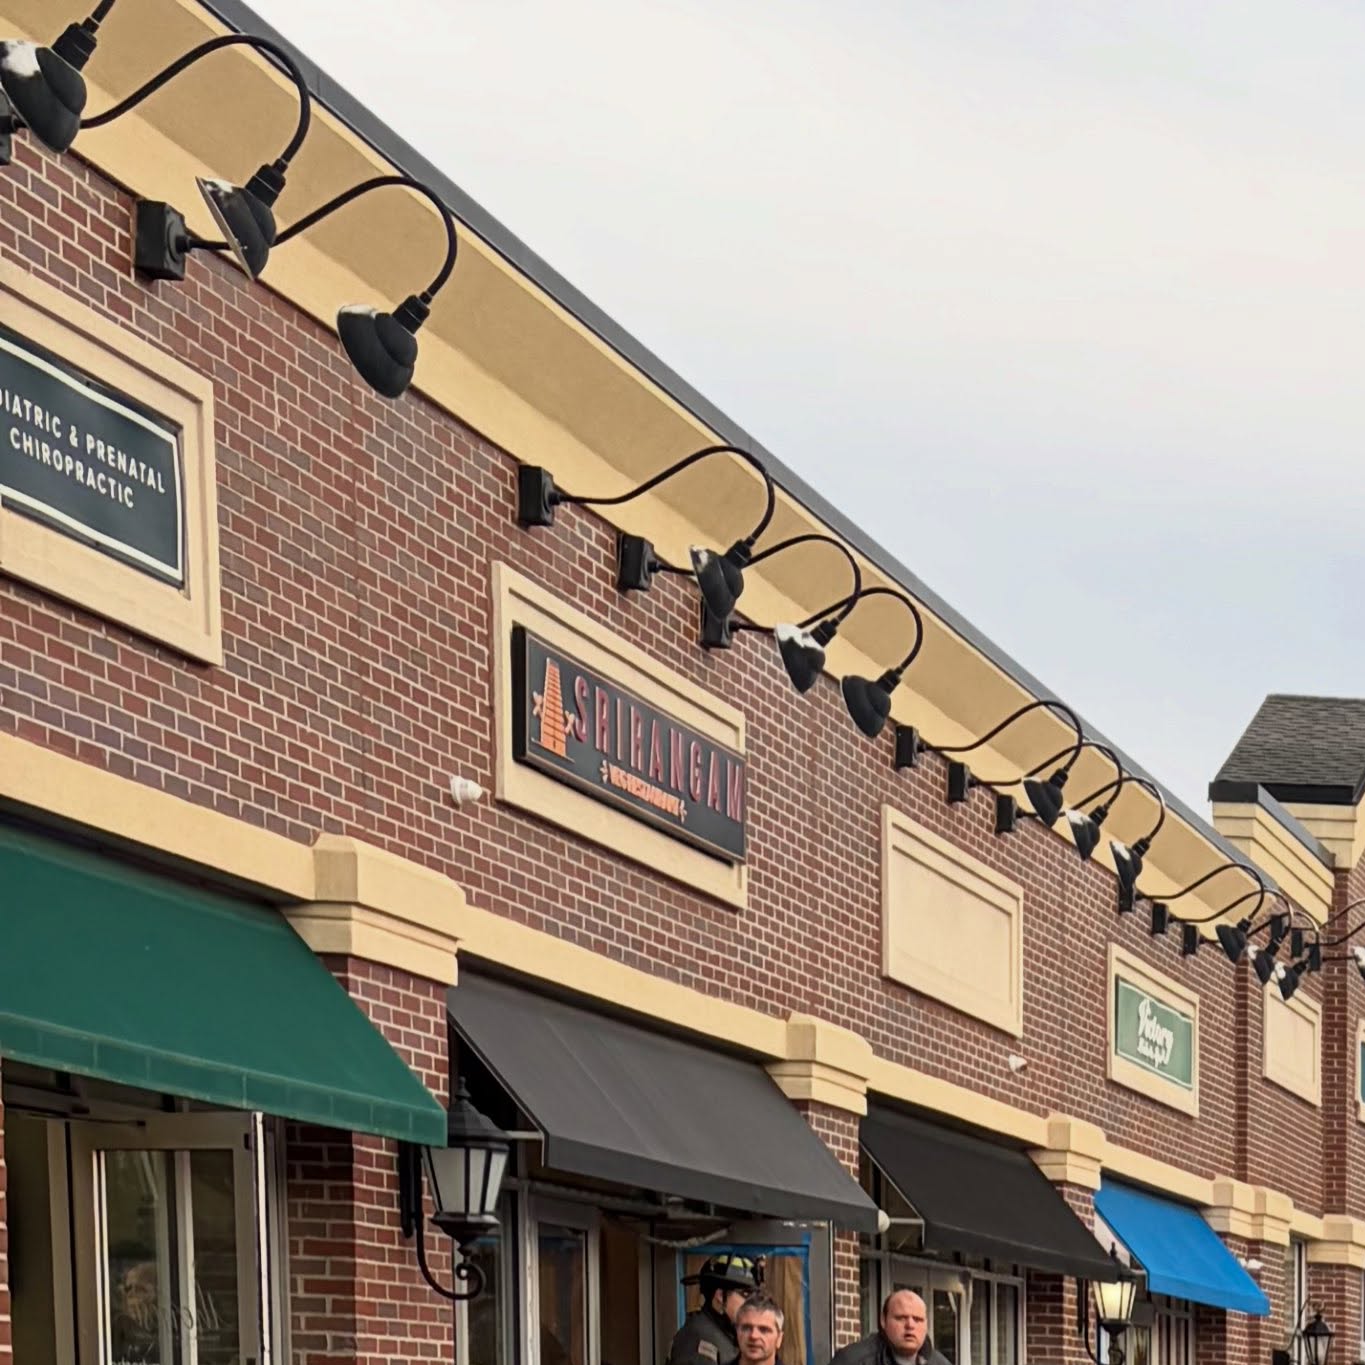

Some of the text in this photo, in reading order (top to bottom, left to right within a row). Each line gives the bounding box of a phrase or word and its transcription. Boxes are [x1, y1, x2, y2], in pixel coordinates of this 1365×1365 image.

[9, 427, 134, 509] CHIROPRACTIC
[69, 425, 79, 448] &
[86, 433, 166, 494] PRENATAL
[574, 675, 743, 824] SRIRANGAM
